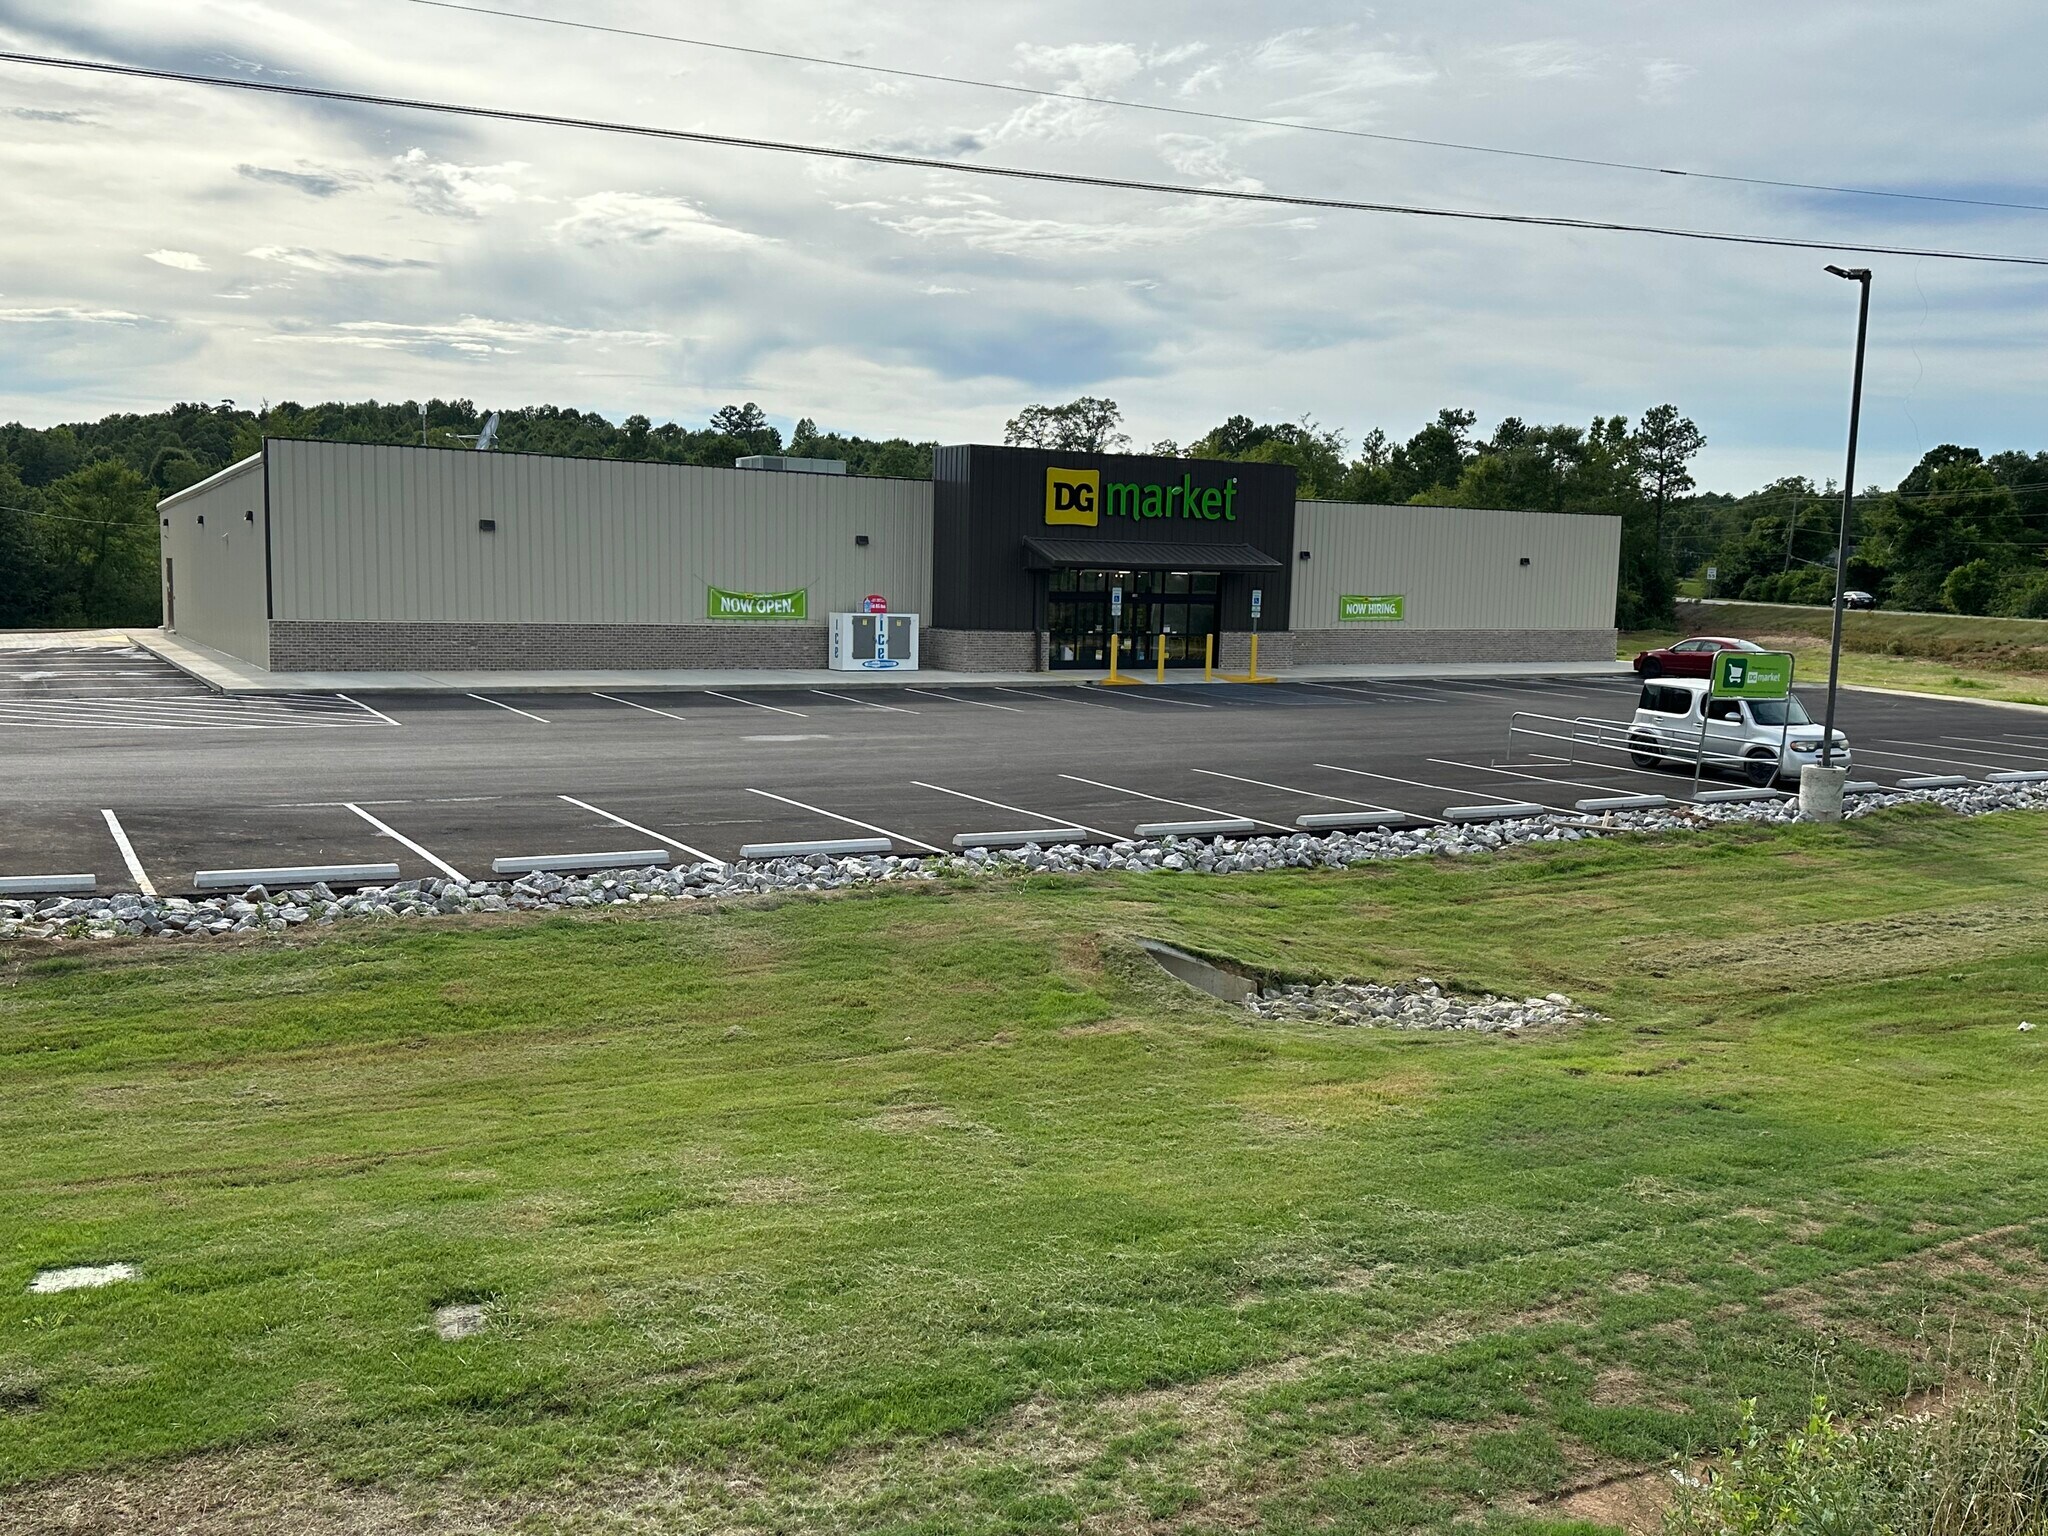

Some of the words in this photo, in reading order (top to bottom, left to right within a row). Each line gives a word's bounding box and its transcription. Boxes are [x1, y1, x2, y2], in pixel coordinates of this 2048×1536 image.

[1053, 482, 1094, 512] DG
[1107, 473, 1236, 521] market
[720, 597, 753, 613] NOW
[756, 599, 795, 614] OPEN.
[1346, 603, 1366, 614] NOW
[1368, 603, 1397, 614] HIRING.
[1758, 672, 1781, 682] market
